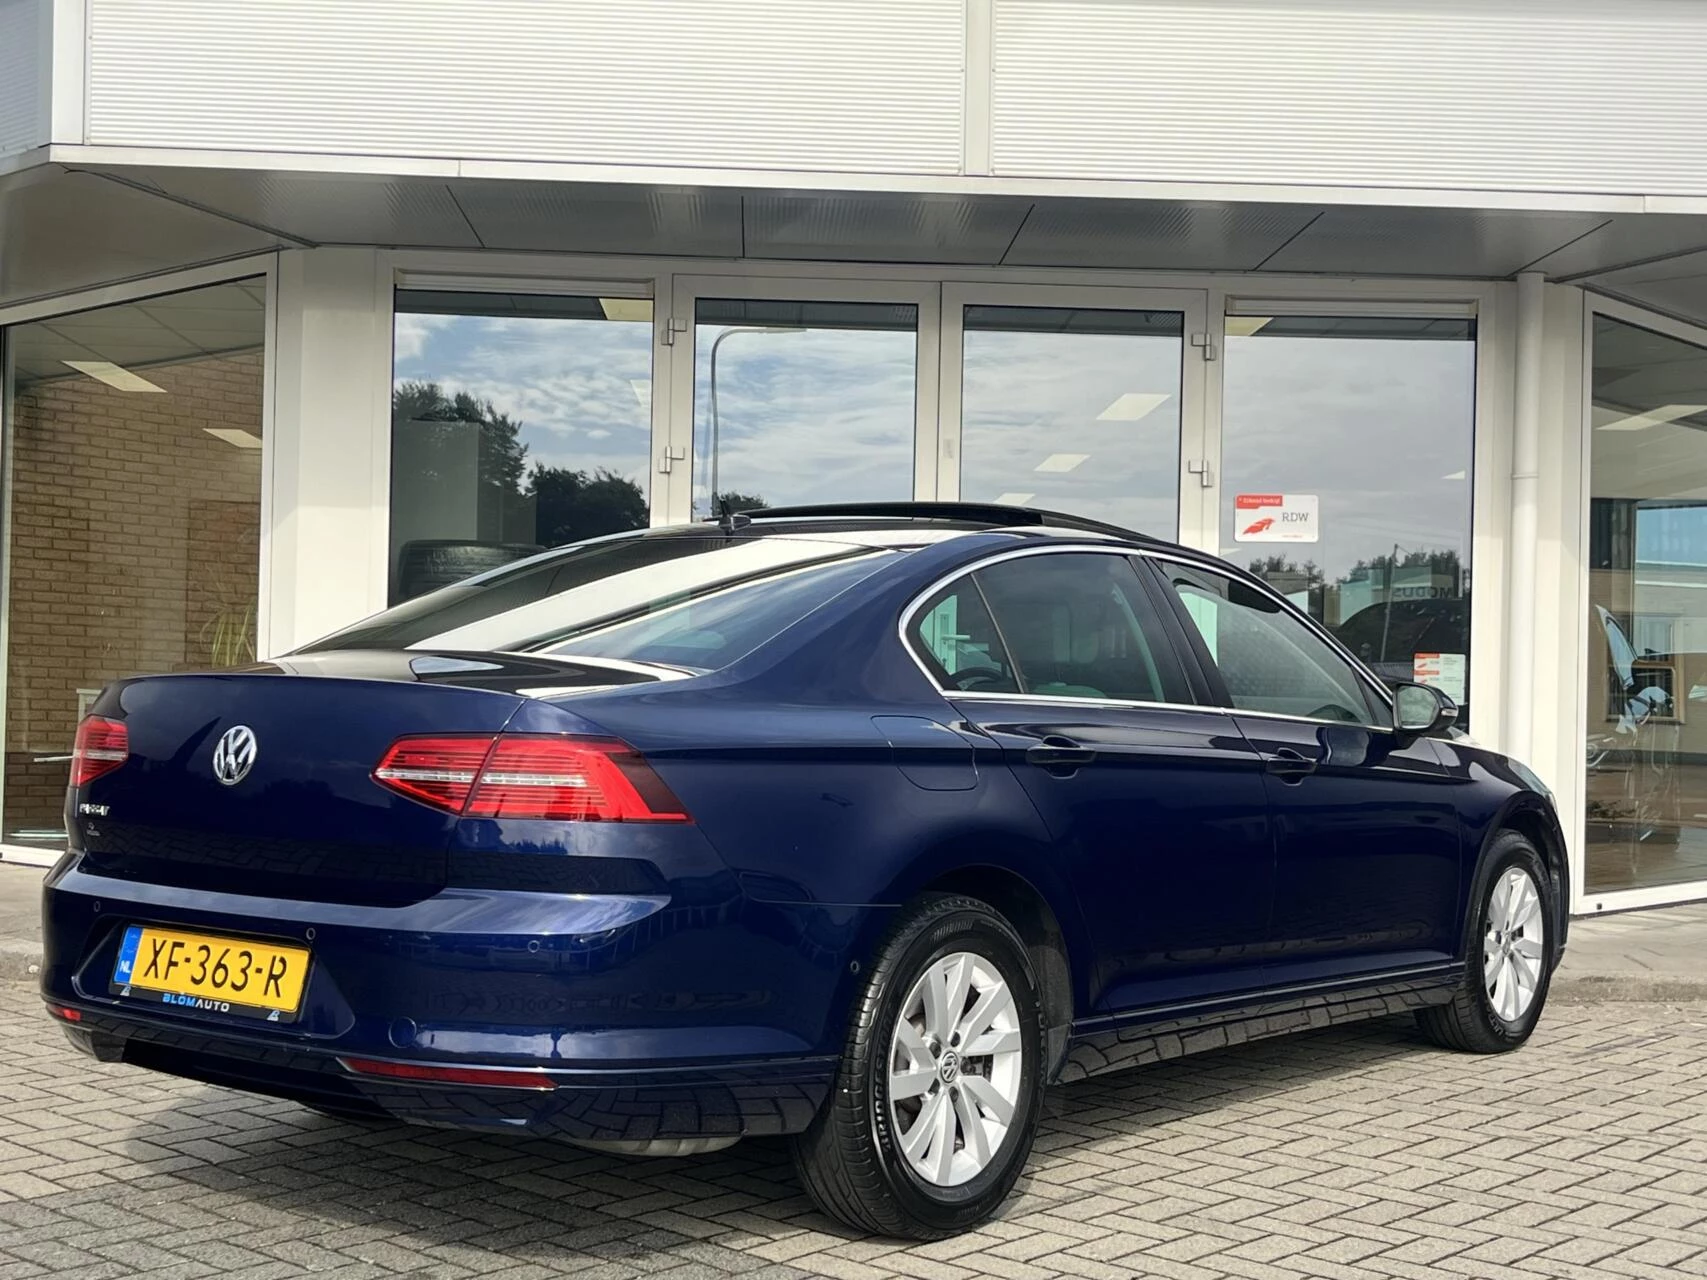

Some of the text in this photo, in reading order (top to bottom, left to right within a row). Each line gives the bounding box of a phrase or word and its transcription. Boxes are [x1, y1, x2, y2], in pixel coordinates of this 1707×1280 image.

[1282, 512, 1309, 522] RDW
[120, 960, 131, 973] NL
[143, 938, 287, 998] XF-363-R
